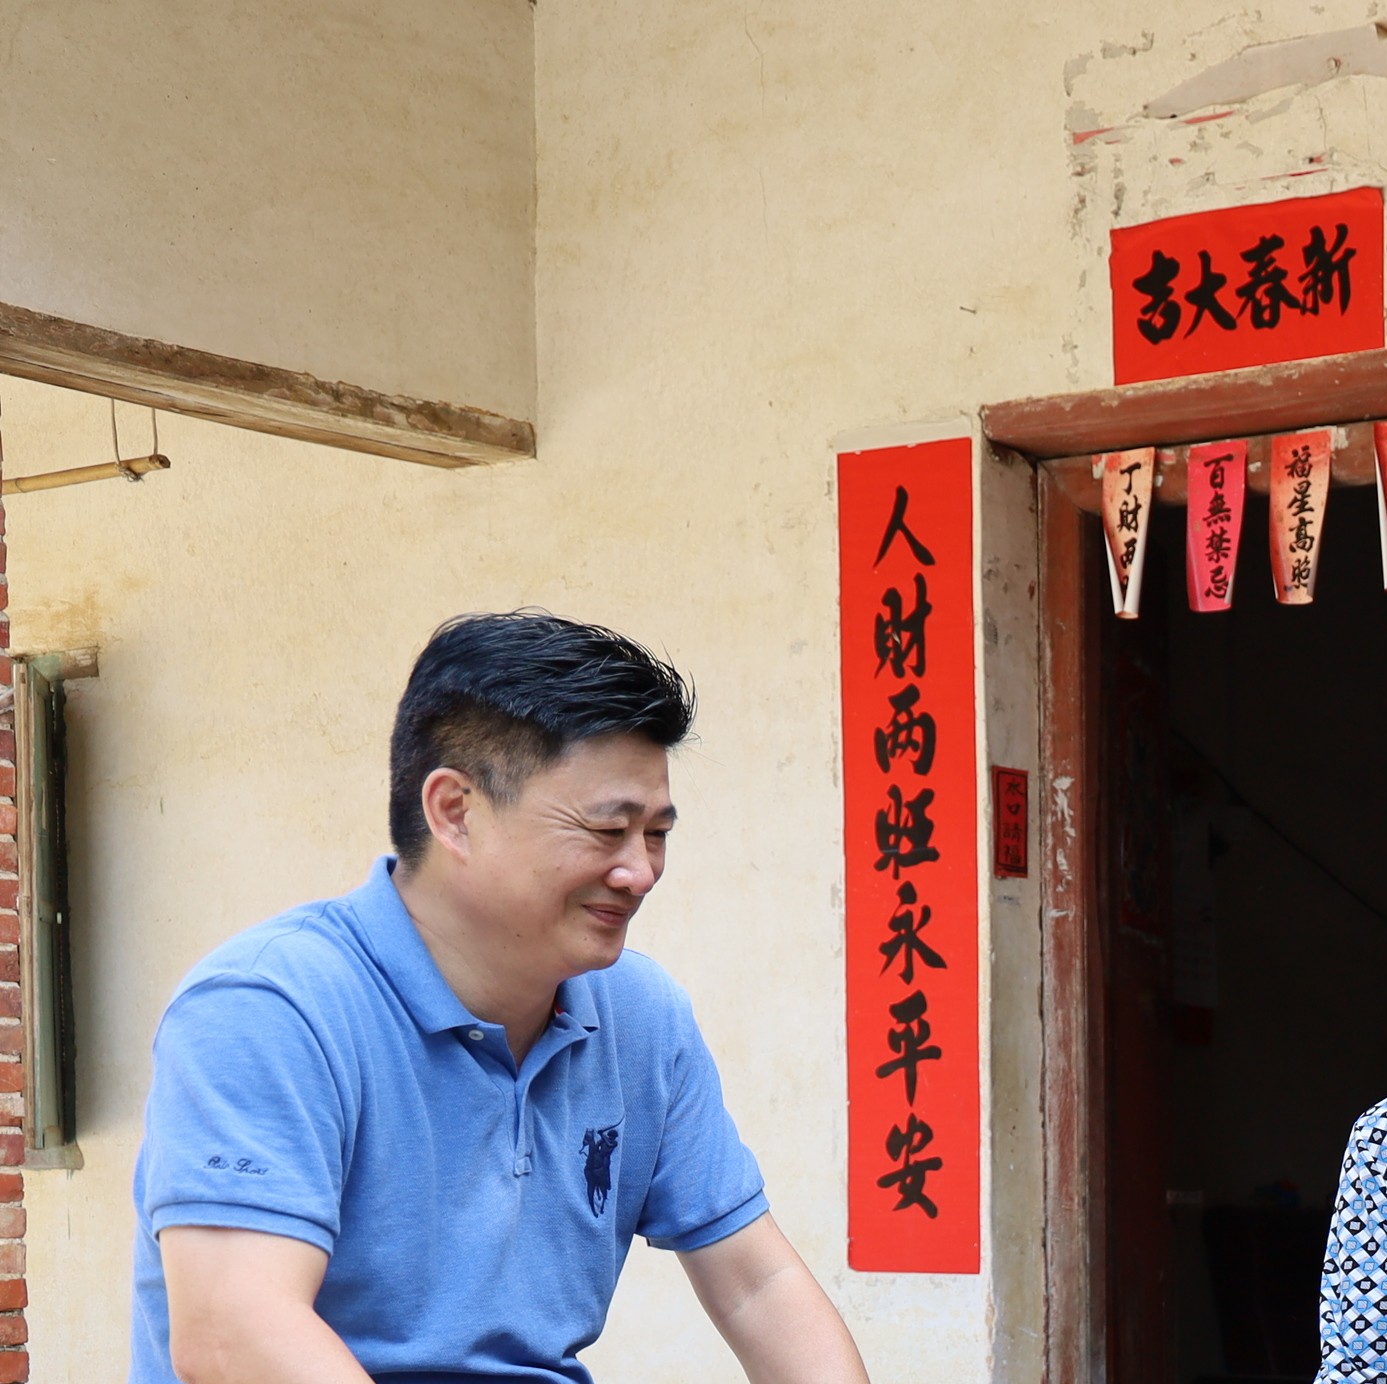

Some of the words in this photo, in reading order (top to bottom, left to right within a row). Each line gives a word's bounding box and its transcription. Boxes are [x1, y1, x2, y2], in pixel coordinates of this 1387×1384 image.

[1132, 223, 1357, 345] 新春大吉
[1203, 453, 1235, 600] 百無禁忌
[1284, 444, 1317, 590] 福星高照
